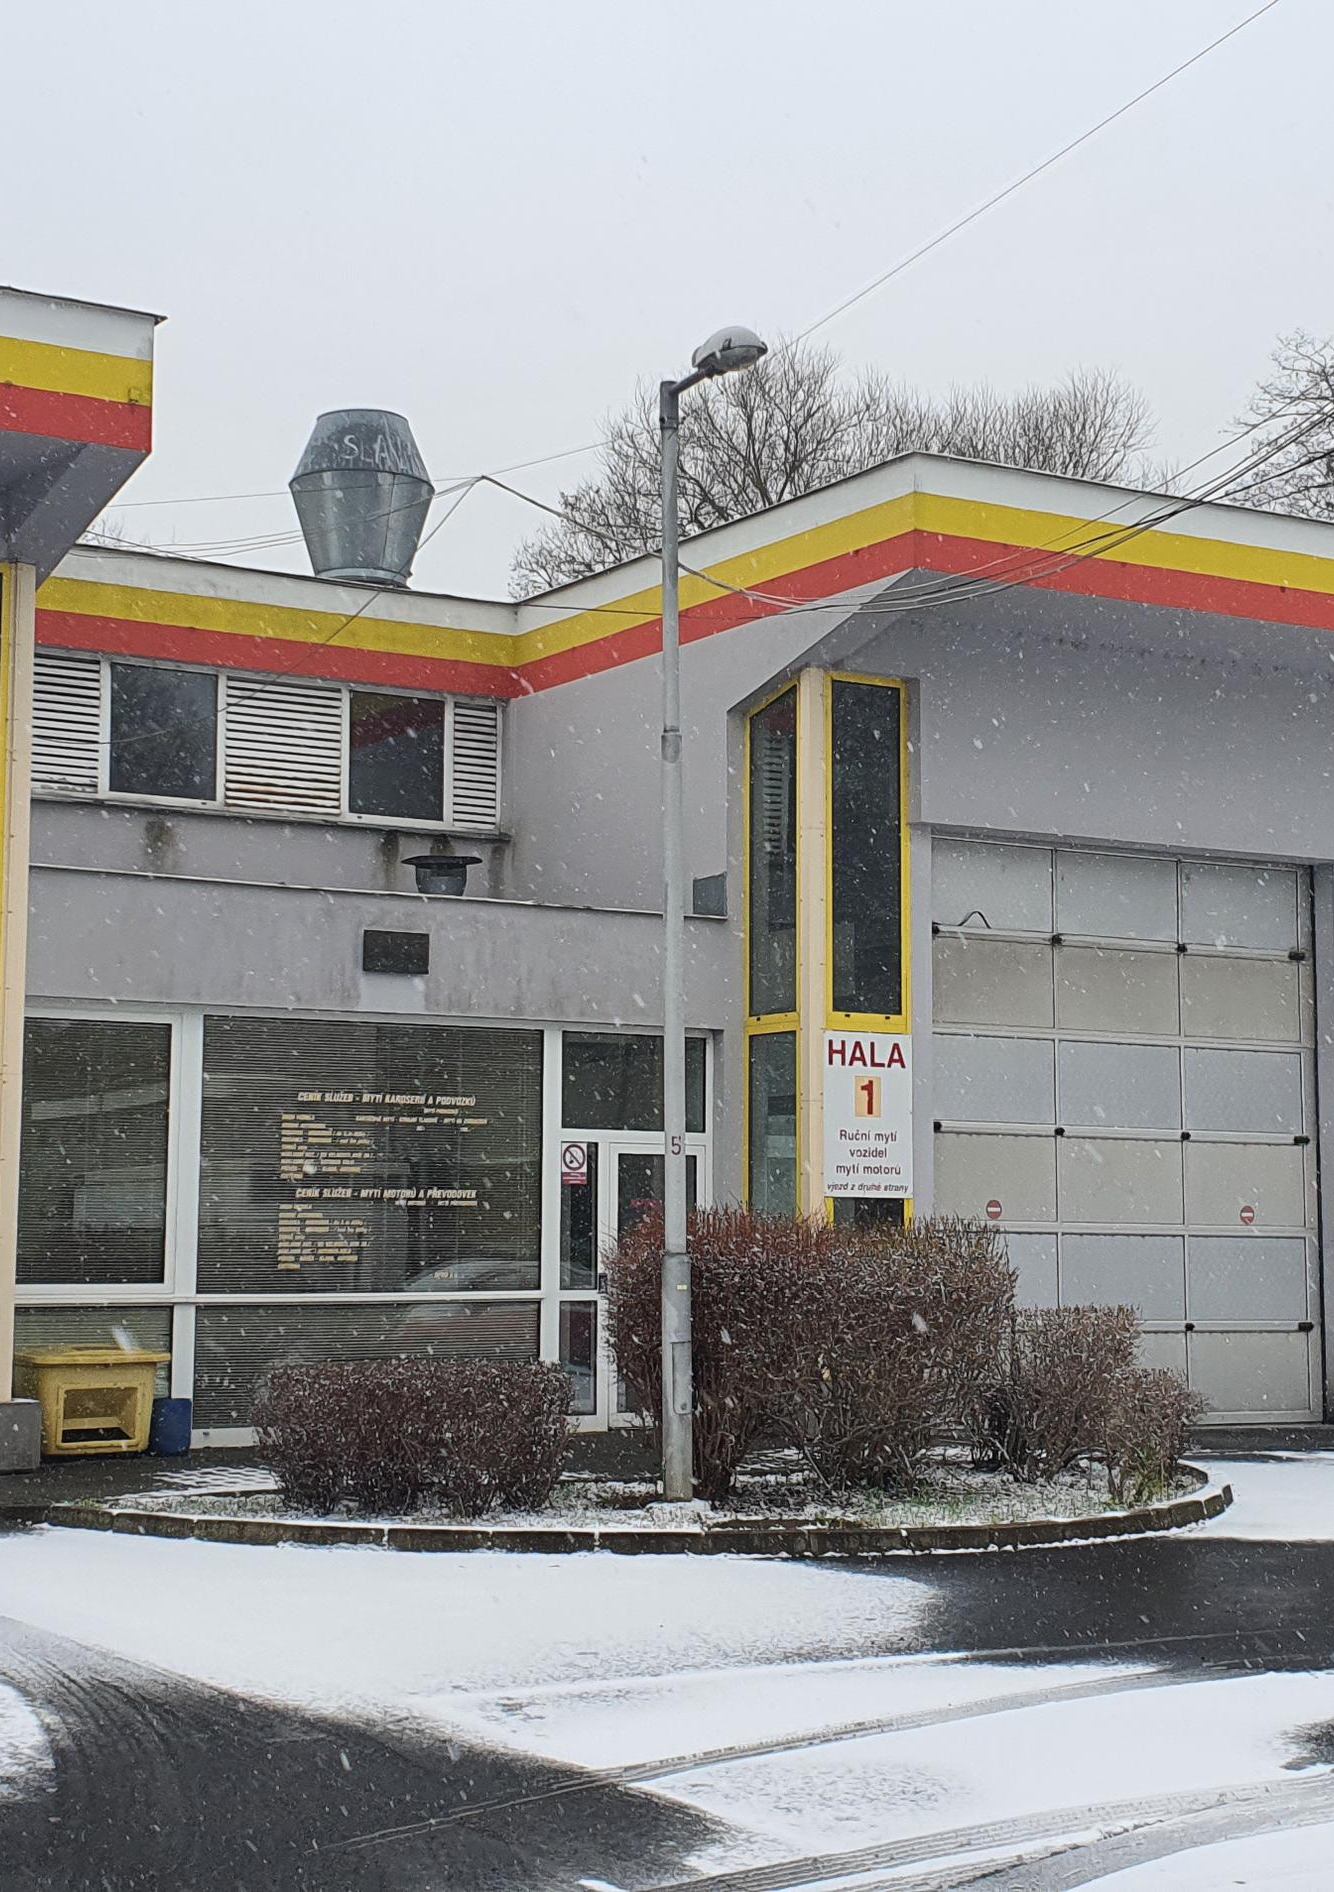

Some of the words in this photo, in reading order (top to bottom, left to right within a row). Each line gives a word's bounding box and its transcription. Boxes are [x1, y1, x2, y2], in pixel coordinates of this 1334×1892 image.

[828, 1039, 906, 1069] HALA
[860, 1079, 874, 1115] 1
[839, 1129, 871, 1142] Ruční
[874, 1131, 897, 1144] mytí
[849, 1147, 887, 1158] vozidel
[835, 1163, 859, 1177] mytí
[850, 1183, 856, 1191] z
